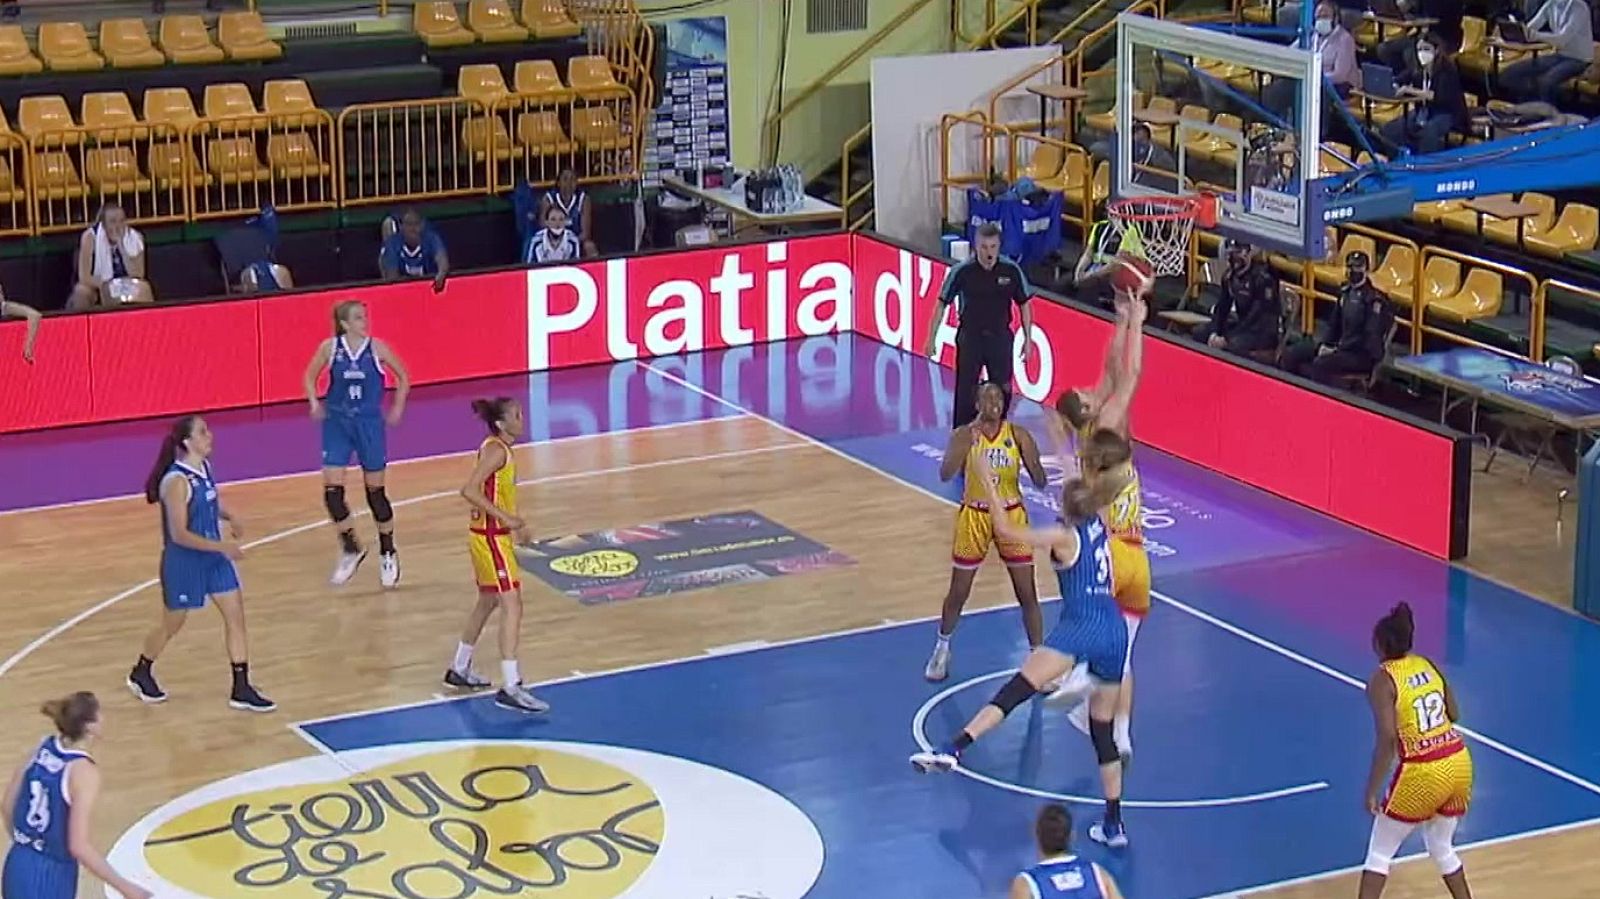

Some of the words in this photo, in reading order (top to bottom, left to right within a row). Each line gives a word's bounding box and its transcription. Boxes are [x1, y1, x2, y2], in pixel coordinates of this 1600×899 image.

[1437, 179, 1475, 193] MONDO
[527, 241, 853, 370] Platia
[874, 248, 1054, 402] d'Ao
[1412, 691, 1445, 733] 12
[144, 764, 633, 848] tierra
[234, 844, 387, 886] de
